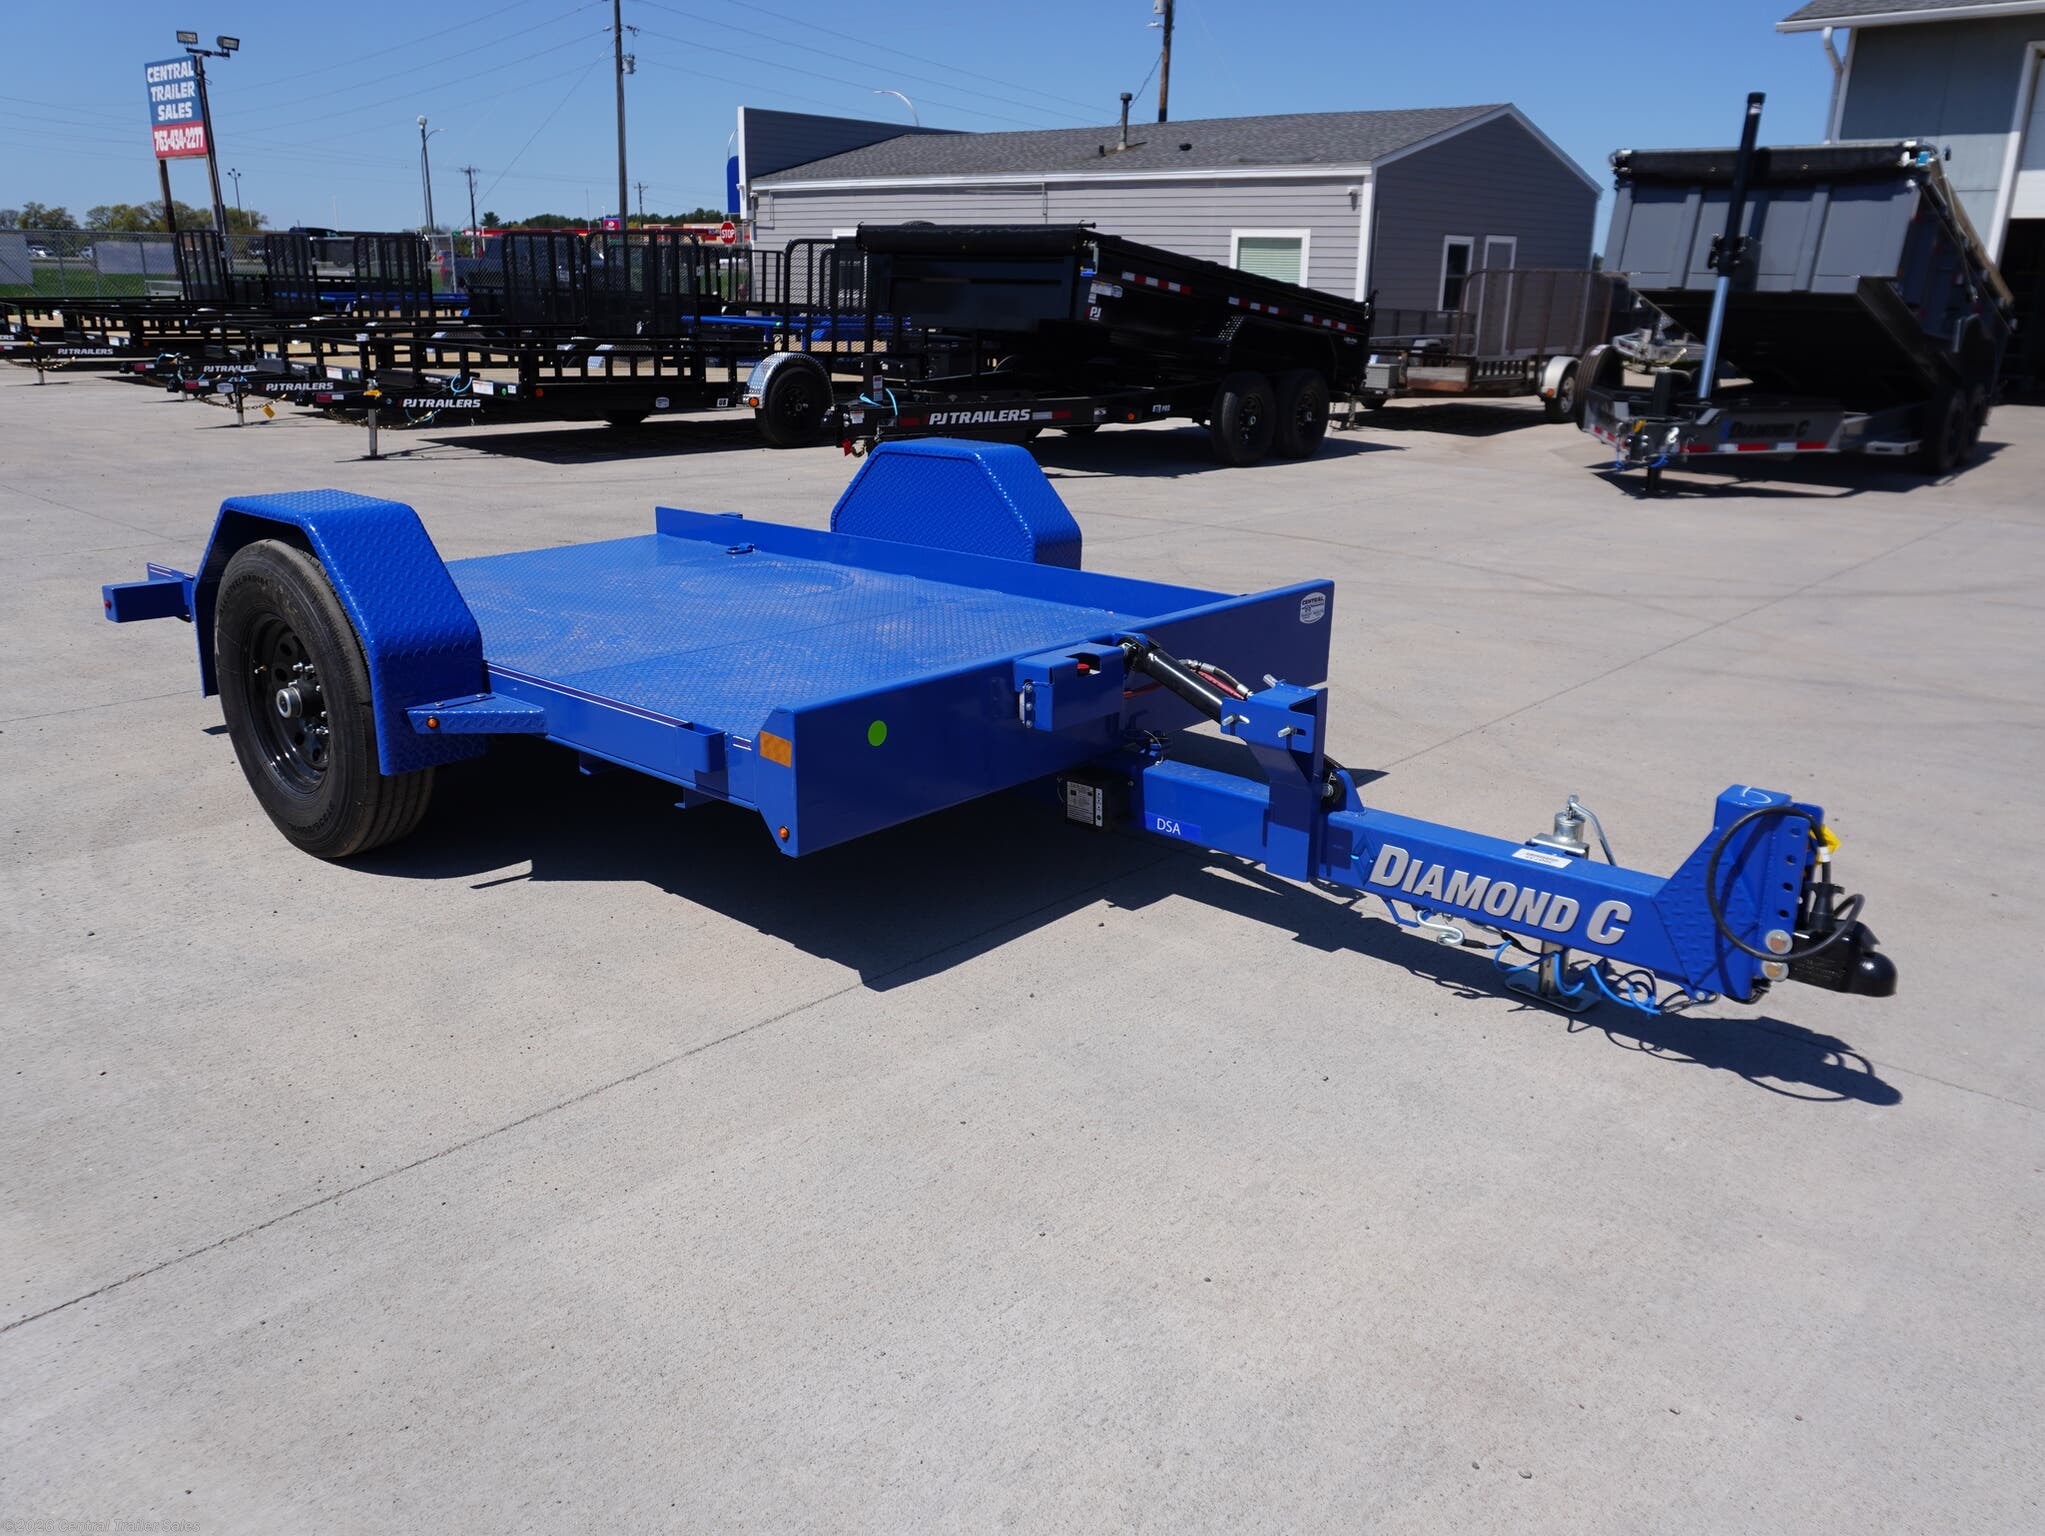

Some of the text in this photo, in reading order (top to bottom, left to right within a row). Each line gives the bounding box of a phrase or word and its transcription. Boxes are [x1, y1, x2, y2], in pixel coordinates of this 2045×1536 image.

[147, 60, 194, 83] CENTRAL
[150, 80, 195, 102] TRAILER
[158, 101, 192, 121] SALES
[721, 229, 735, 239] STOP
[1090, 306, 1102, 318] PJ
[1157, 817, 1181, 836] DSA
[1369, 843, 1632, 945] DIAMOND C
